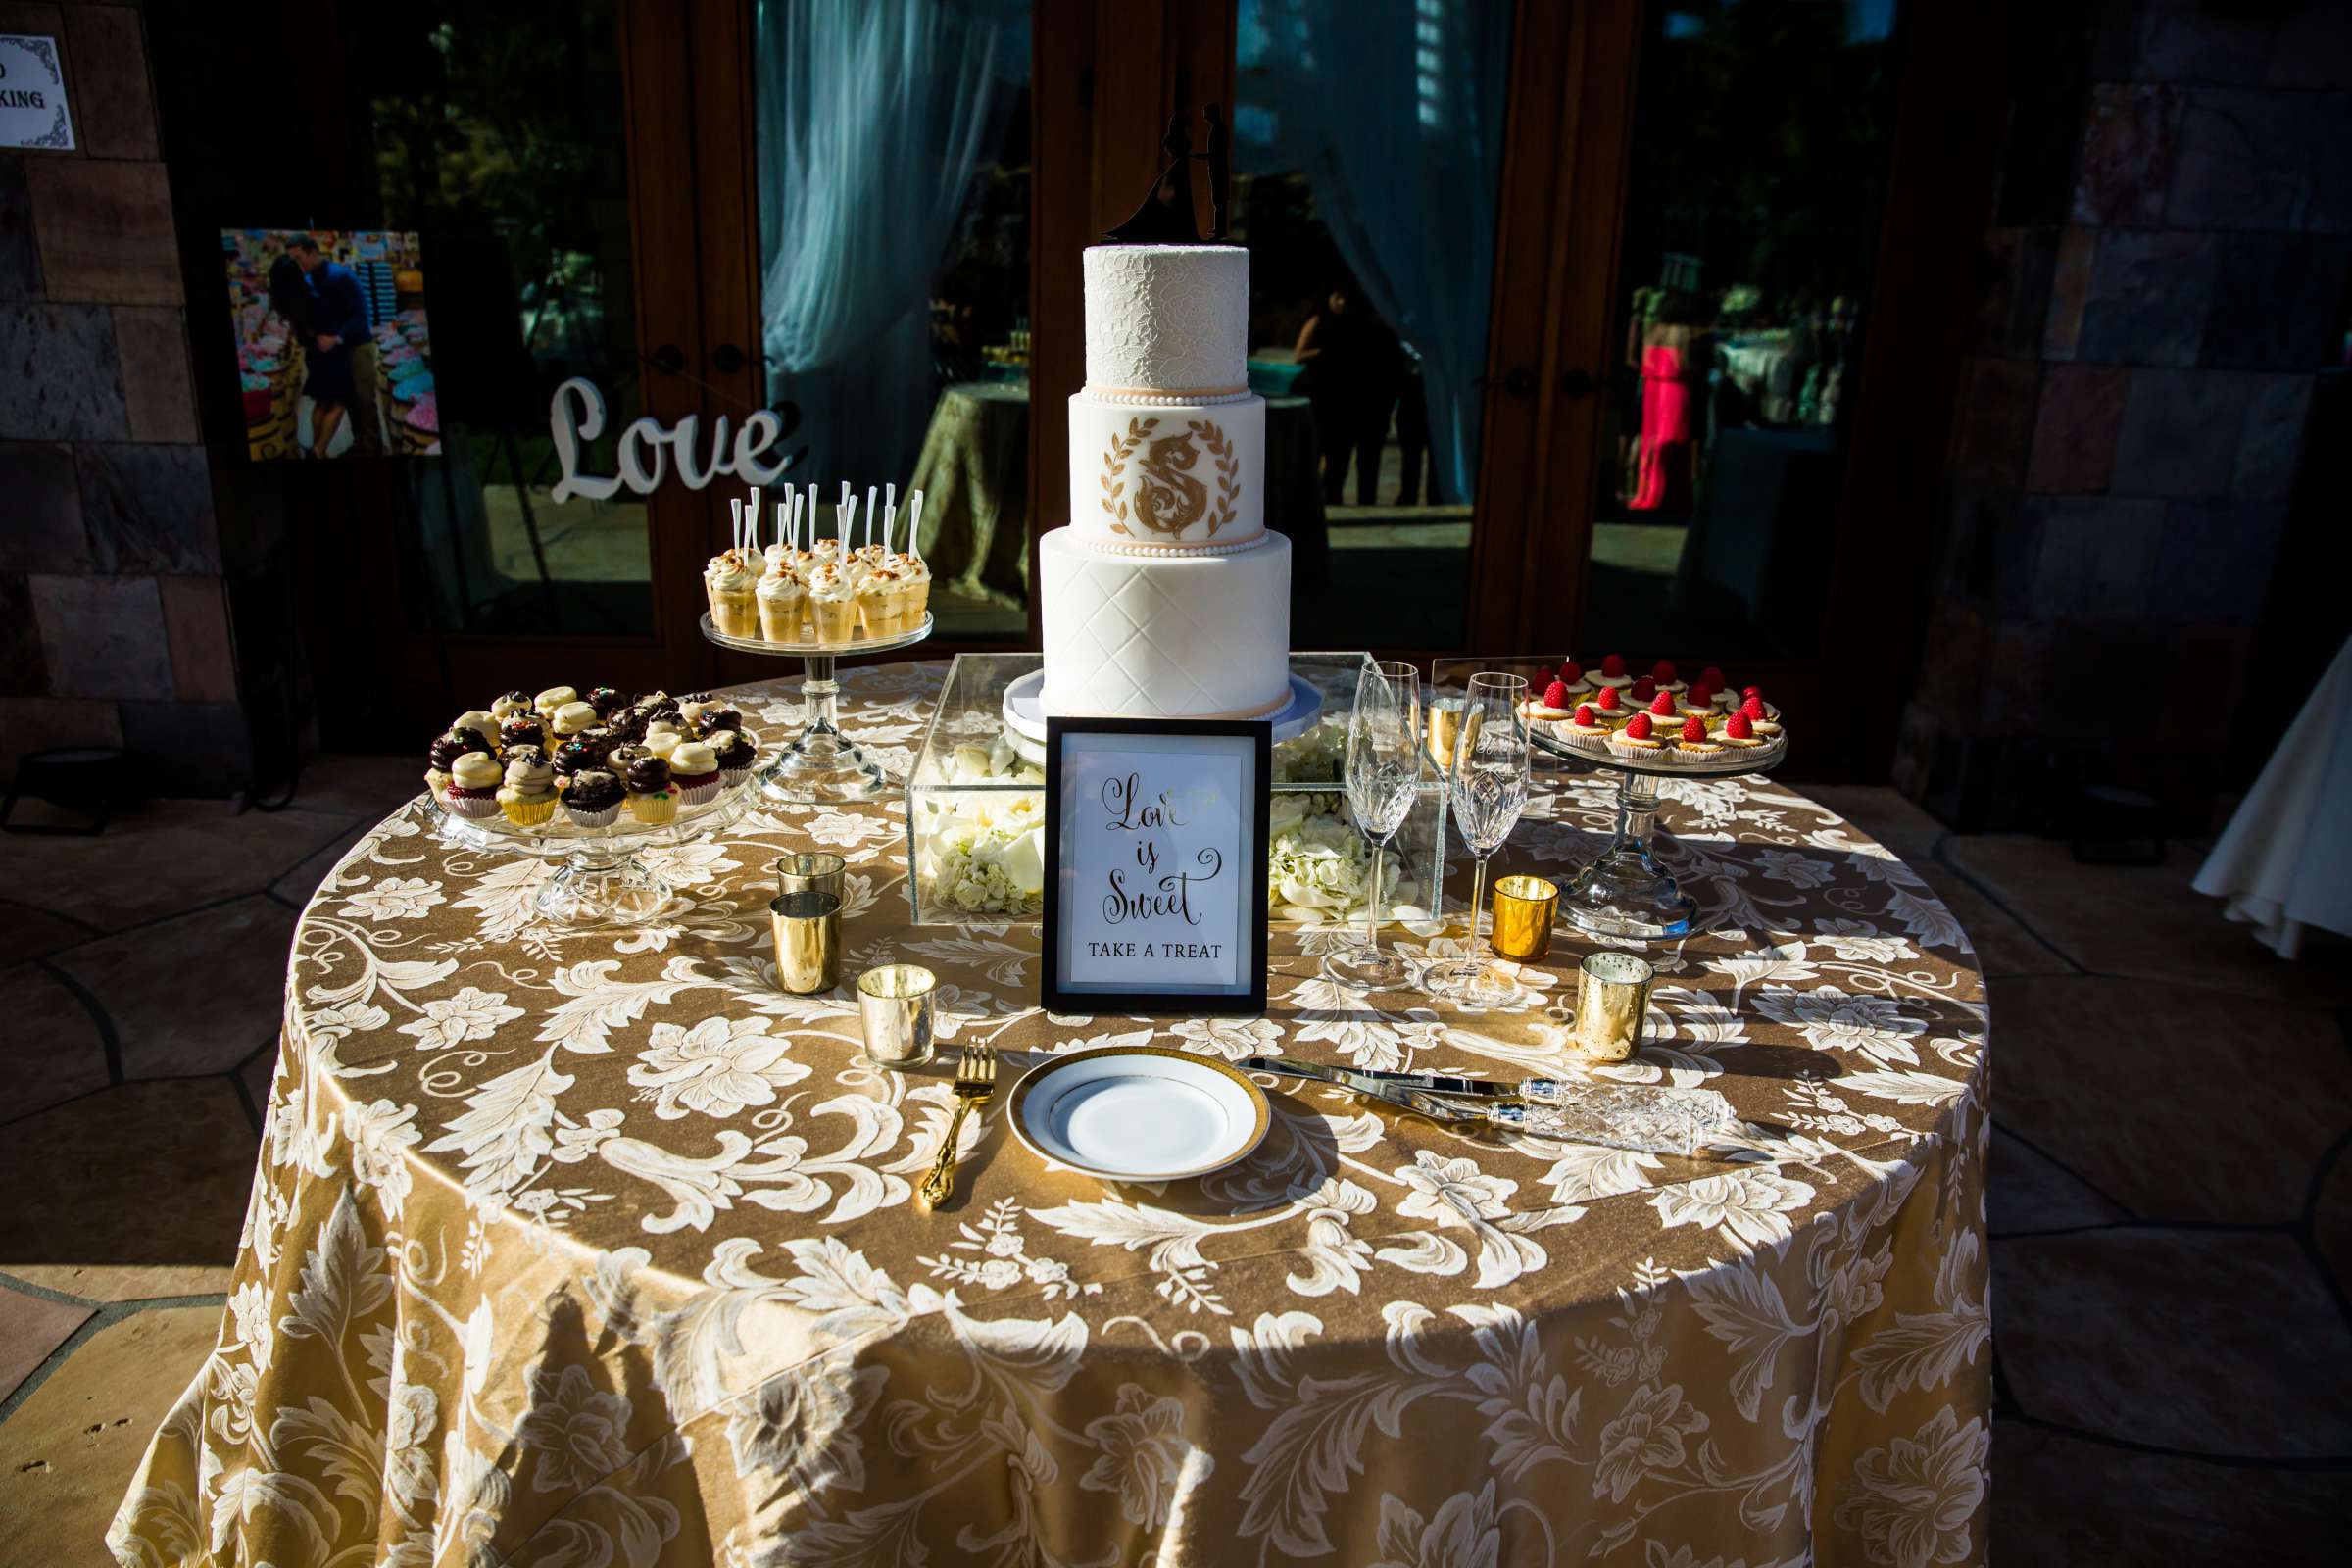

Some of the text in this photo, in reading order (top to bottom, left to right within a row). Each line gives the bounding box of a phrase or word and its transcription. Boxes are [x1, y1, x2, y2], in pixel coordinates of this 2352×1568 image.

[551, 376, 792, 504] Love
[1136, 840, 1159, 874] is
[1102, 847, 1222, 925] Sweet
[1088, 942, 1222, 958] TAKE A TREAT
